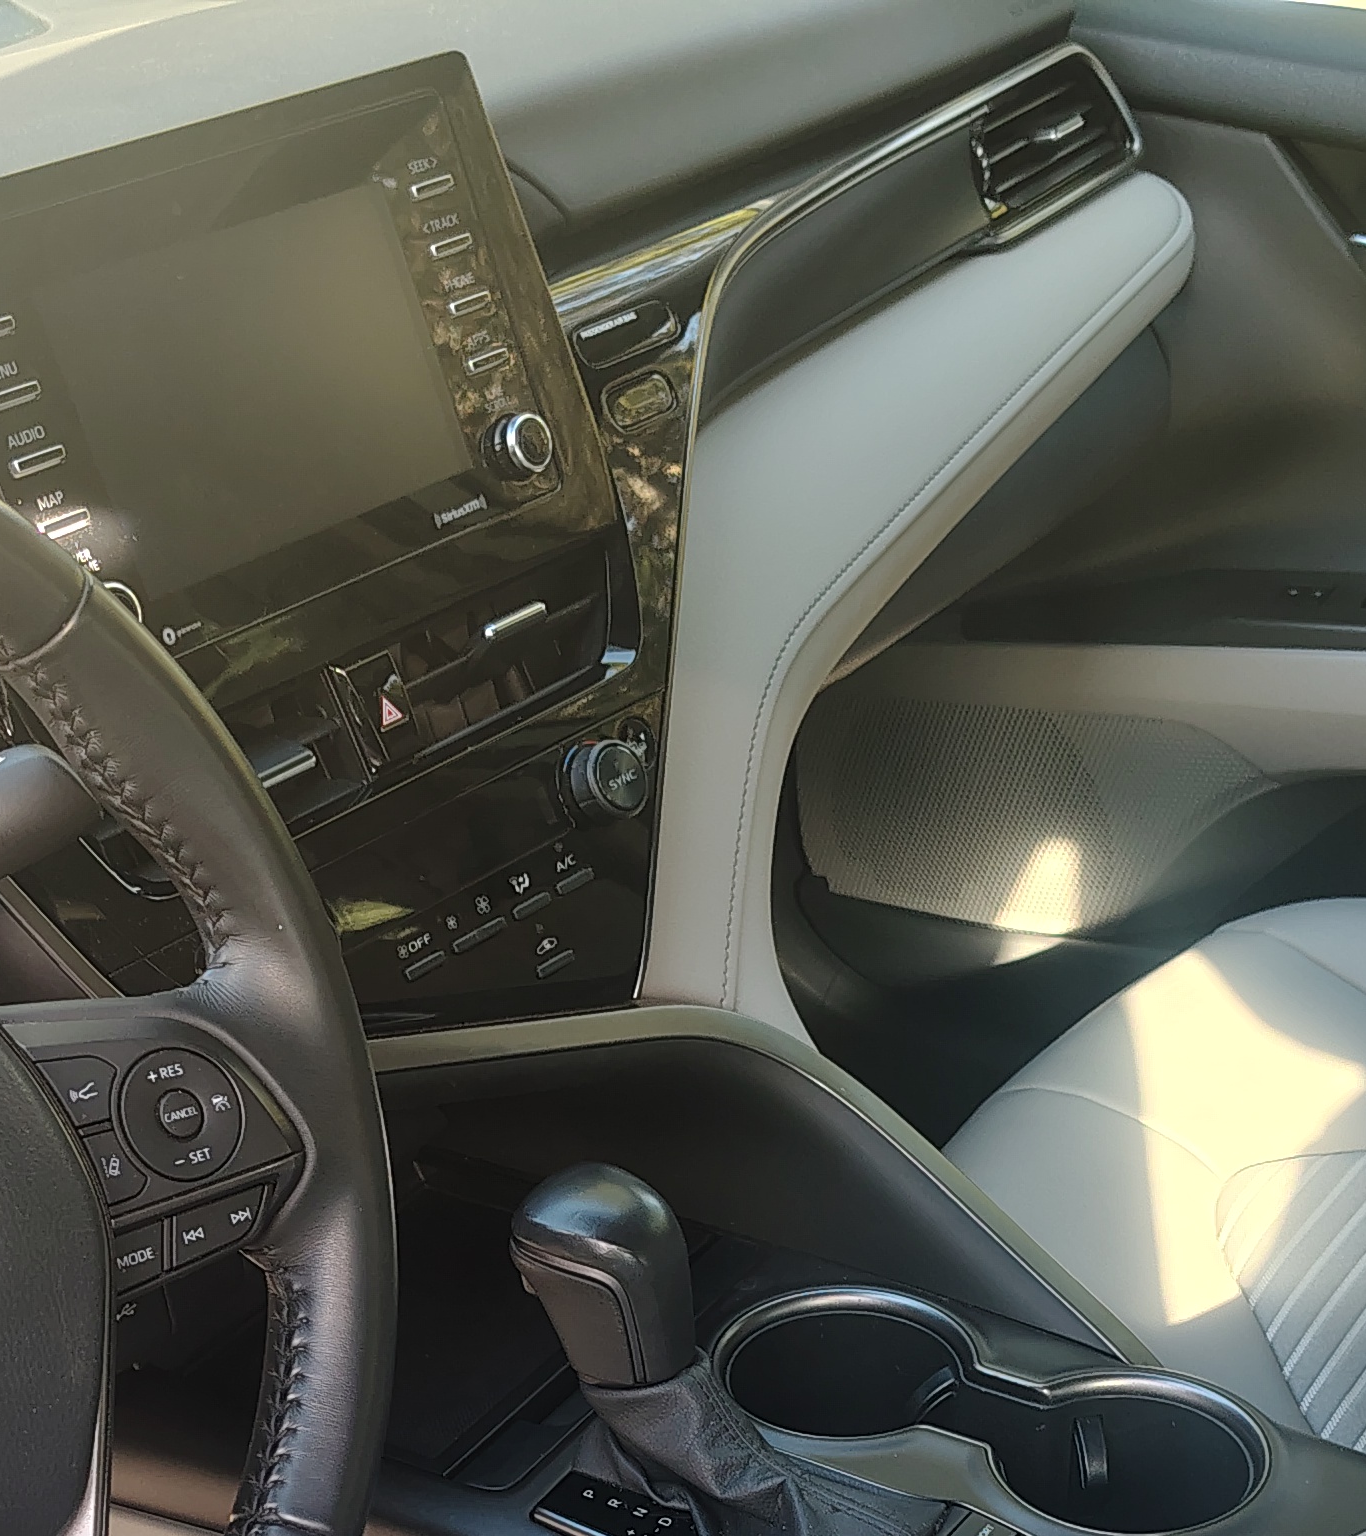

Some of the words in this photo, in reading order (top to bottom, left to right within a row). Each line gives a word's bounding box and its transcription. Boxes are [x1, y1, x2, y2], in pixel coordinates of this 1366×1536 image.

[7, 425, 46, 450] AUDIO
[36, 490, 65, 512] MAP
[608, 769, 639, 792] SYNC
[555, 853, 577, 872] A/C
[408, 932, 432, 953] OFF
[164, 1106, 198, 1123] CANCEL
[116, 1247, 155, 1270] MODE
[582, 1489, 594, 1499] P
[606, 1498, 623, 1508] R
[632, 1507, 649, 1518] N
[657, 1517, 672, 1527] D
